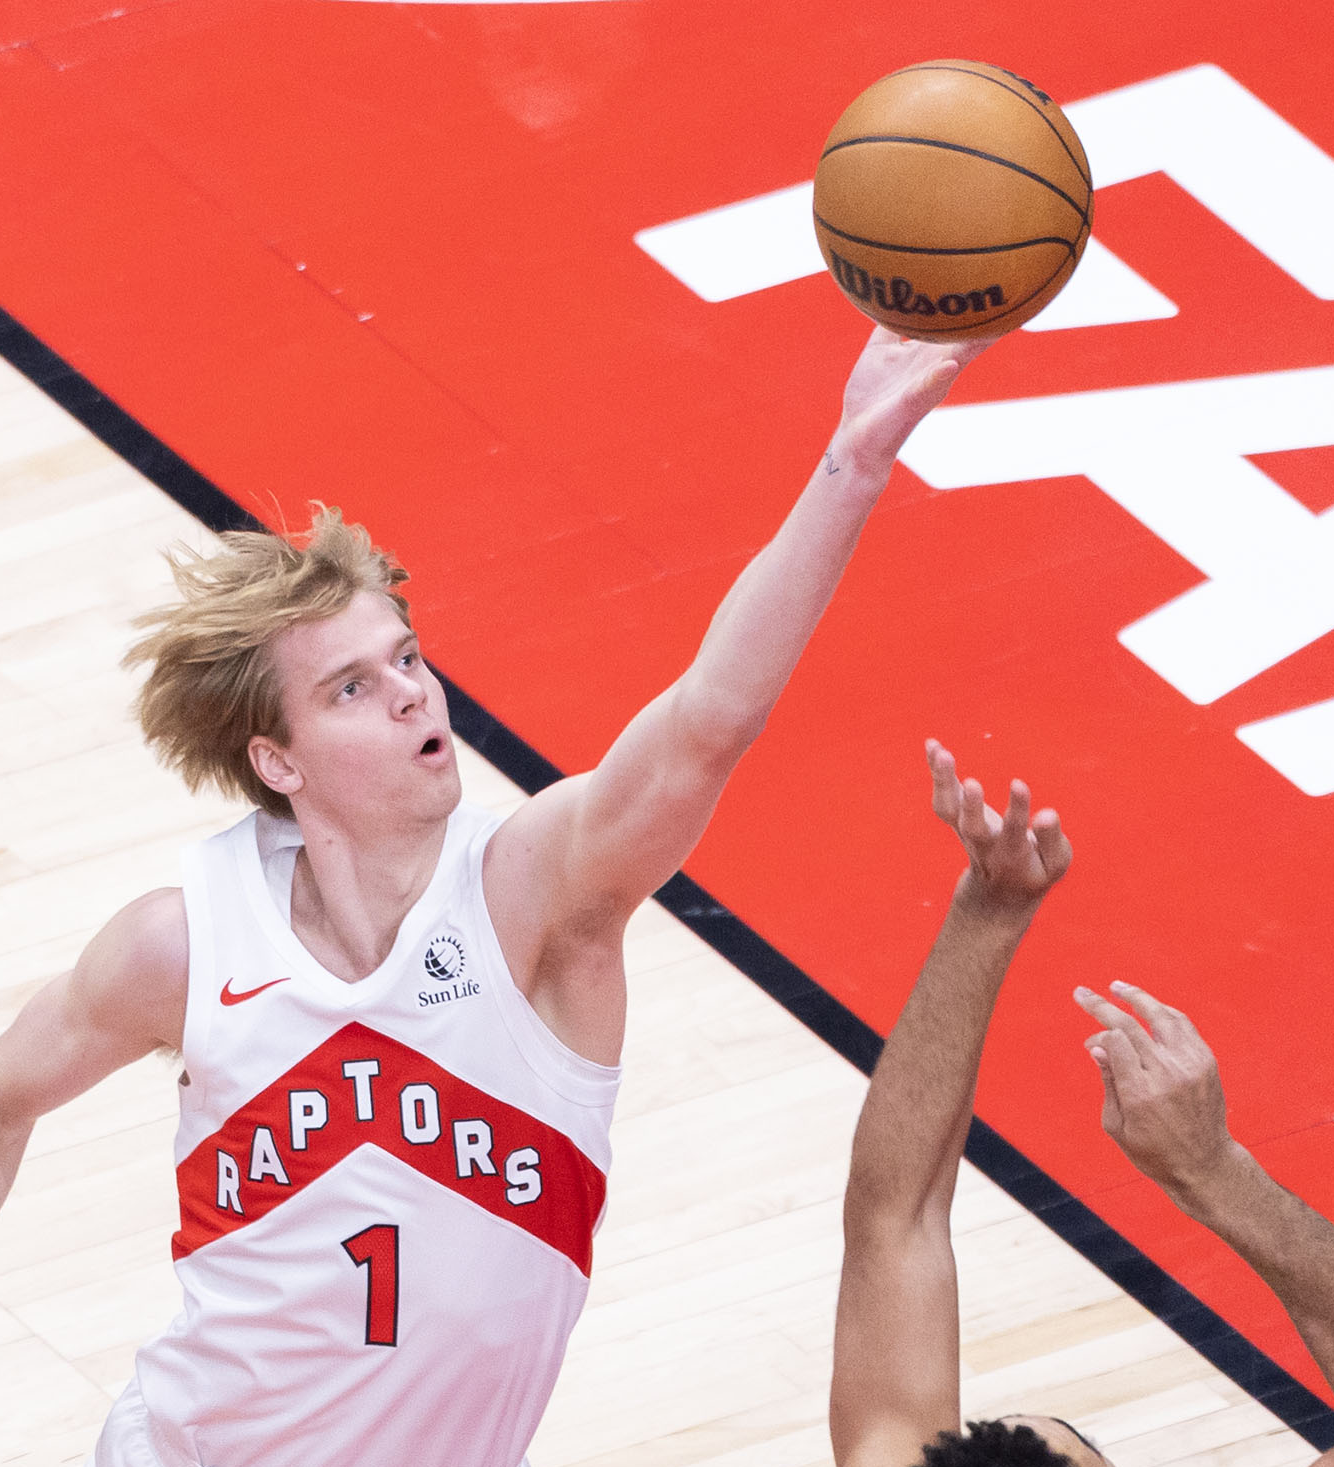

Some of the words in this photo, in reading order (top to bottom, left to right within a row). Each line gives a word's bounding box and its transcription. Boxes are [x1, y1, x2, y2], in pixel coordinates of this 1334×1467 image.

[830, 249, 1007, 315] Wilson
[418, 990, 451, 1007] Sun
[453, 979, 480, 1000] Life
[217, 1059, 543, 1215] RAPTORS
[341, 1224, 400, 1347] 1
